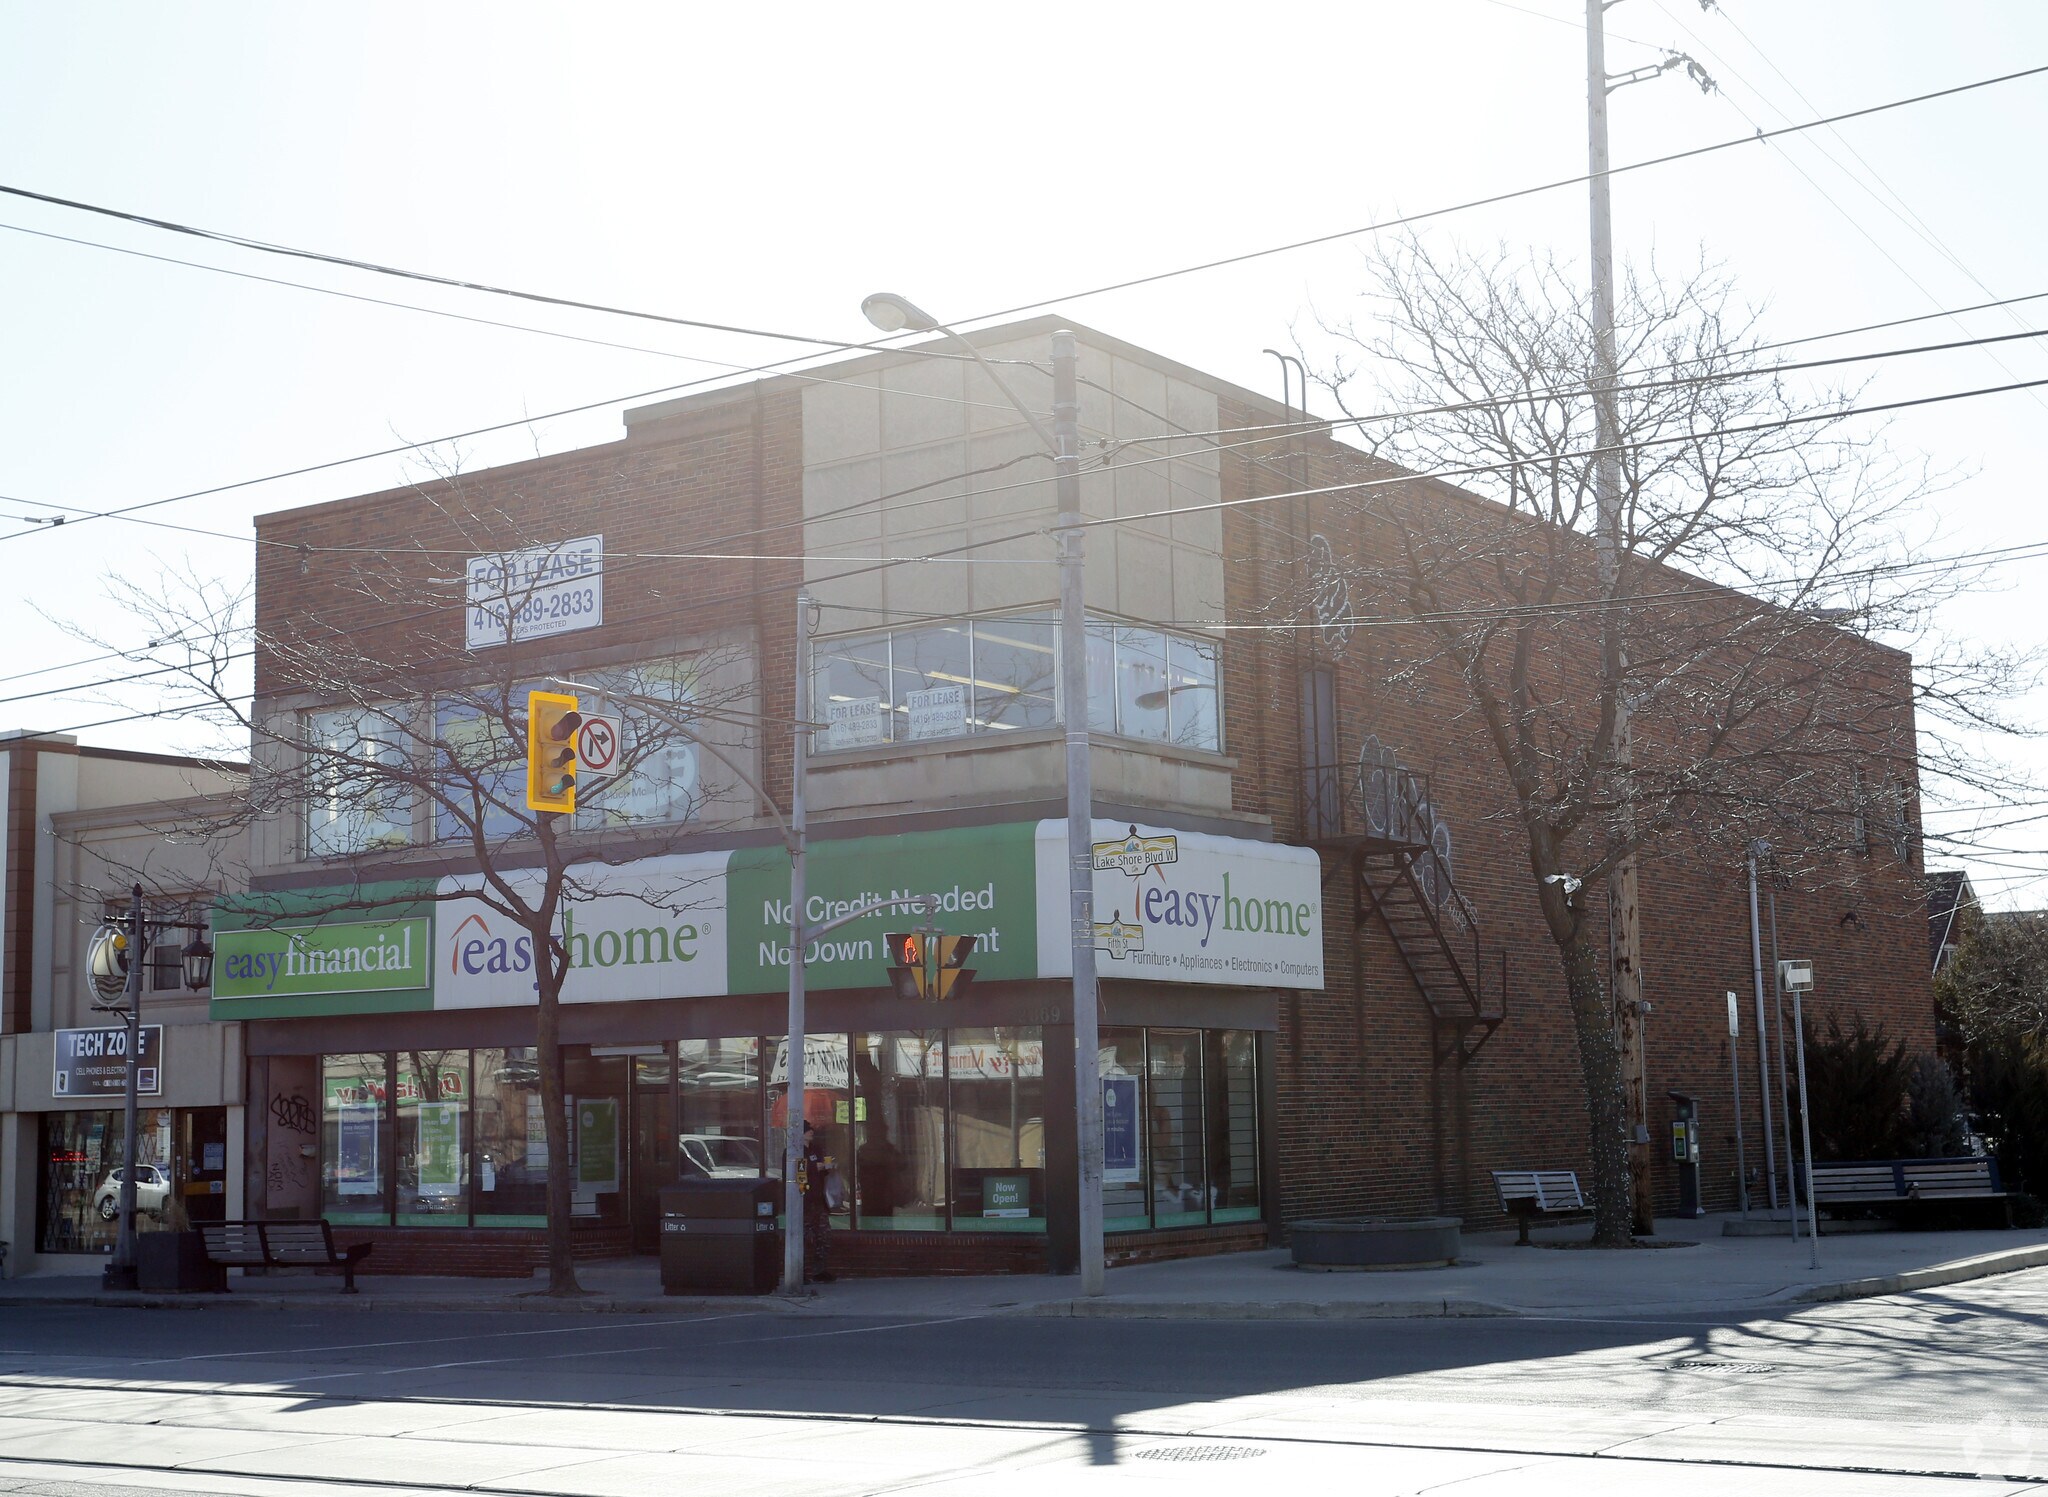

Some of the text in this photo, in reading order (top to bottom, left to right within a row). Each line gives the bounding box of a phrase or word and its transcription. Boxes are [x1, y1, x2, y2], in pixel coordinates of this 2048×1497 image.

[474, 563, 517, 592] FOR
[524, 548, 593, 584] LEASE
[530, 620, 567, 632] PROTECTED
[911, 690, 960, 708] FOR LEASE
[830, 702, 876, 721] FOR LEASE
[1096, 849, 1175, 868] Lake Shore Blvd W
[806, 891, 883, 922] Credit
[1145, 872, 1311, 948] easyhome
[759, 940, 792, 967] No
[806, 938, 873, 964] Down
[1107, 938, 1129, 949] Fifth St
[225, 925, 412, 989] easyfinancial
[1133, 950, 1319, 978] Furniture Appliances Electronics Computers
[68, 1031, 146, 1057] TECH ZOE
[995, 1182, 1016, 1192] Now
[992, 1192, 1018, 1205] Open!
[664, 1222, 679, 1232] Litter
